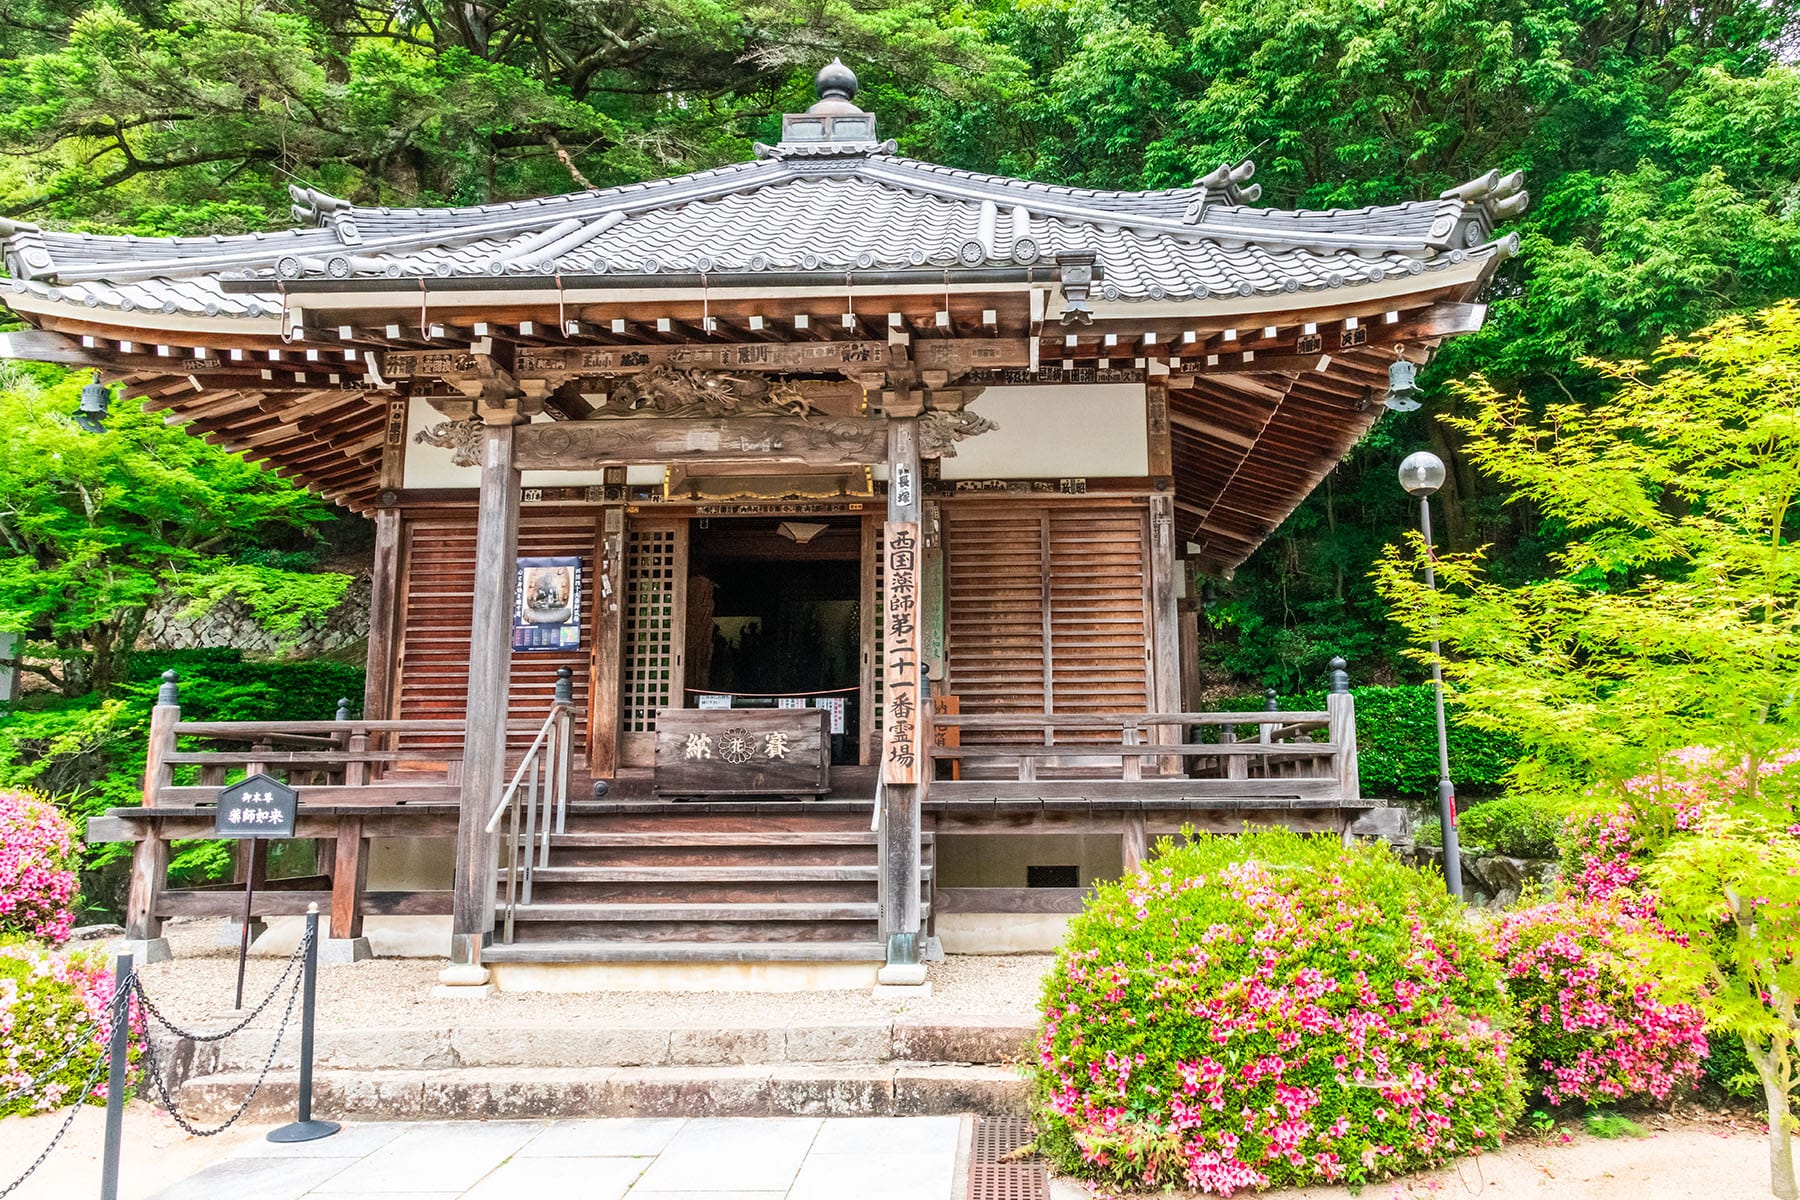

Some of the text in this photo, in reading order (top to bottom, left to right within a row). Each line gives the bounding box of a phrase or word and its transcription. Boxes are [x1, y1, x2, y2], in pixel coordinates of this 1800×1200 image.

[889, 531, 916, 769] 西国薬師第二十一番霊場
[686, 731, 792, 760] 納 花 賽
[241, 791, 274, 804] 御本尊
[228, 808, 284, 825] 薬師如来
